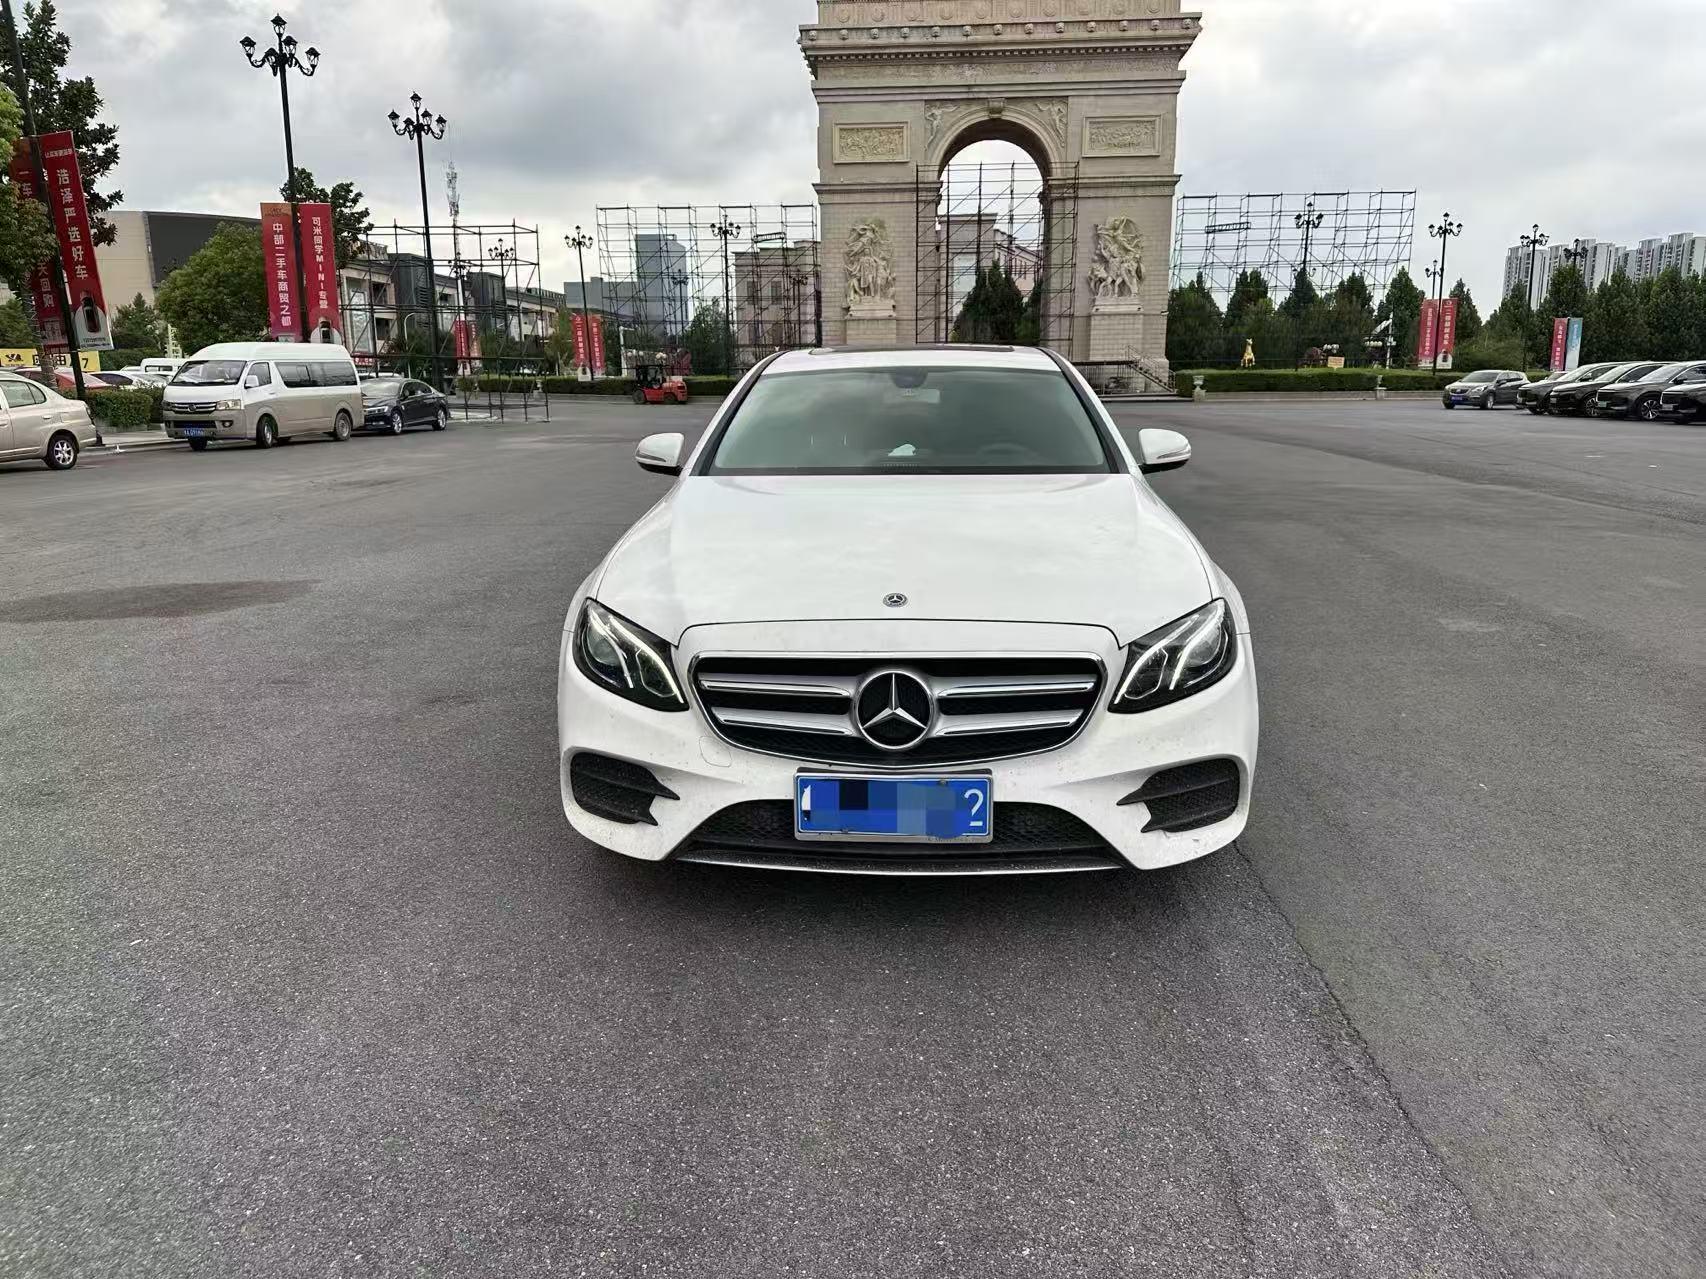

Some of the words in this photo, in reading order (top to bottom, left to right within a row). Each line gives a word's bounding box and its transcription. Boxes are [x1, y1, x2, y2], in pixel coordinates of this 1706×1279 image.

[273, 223, 292, 326] 中部二手车商贸之都
